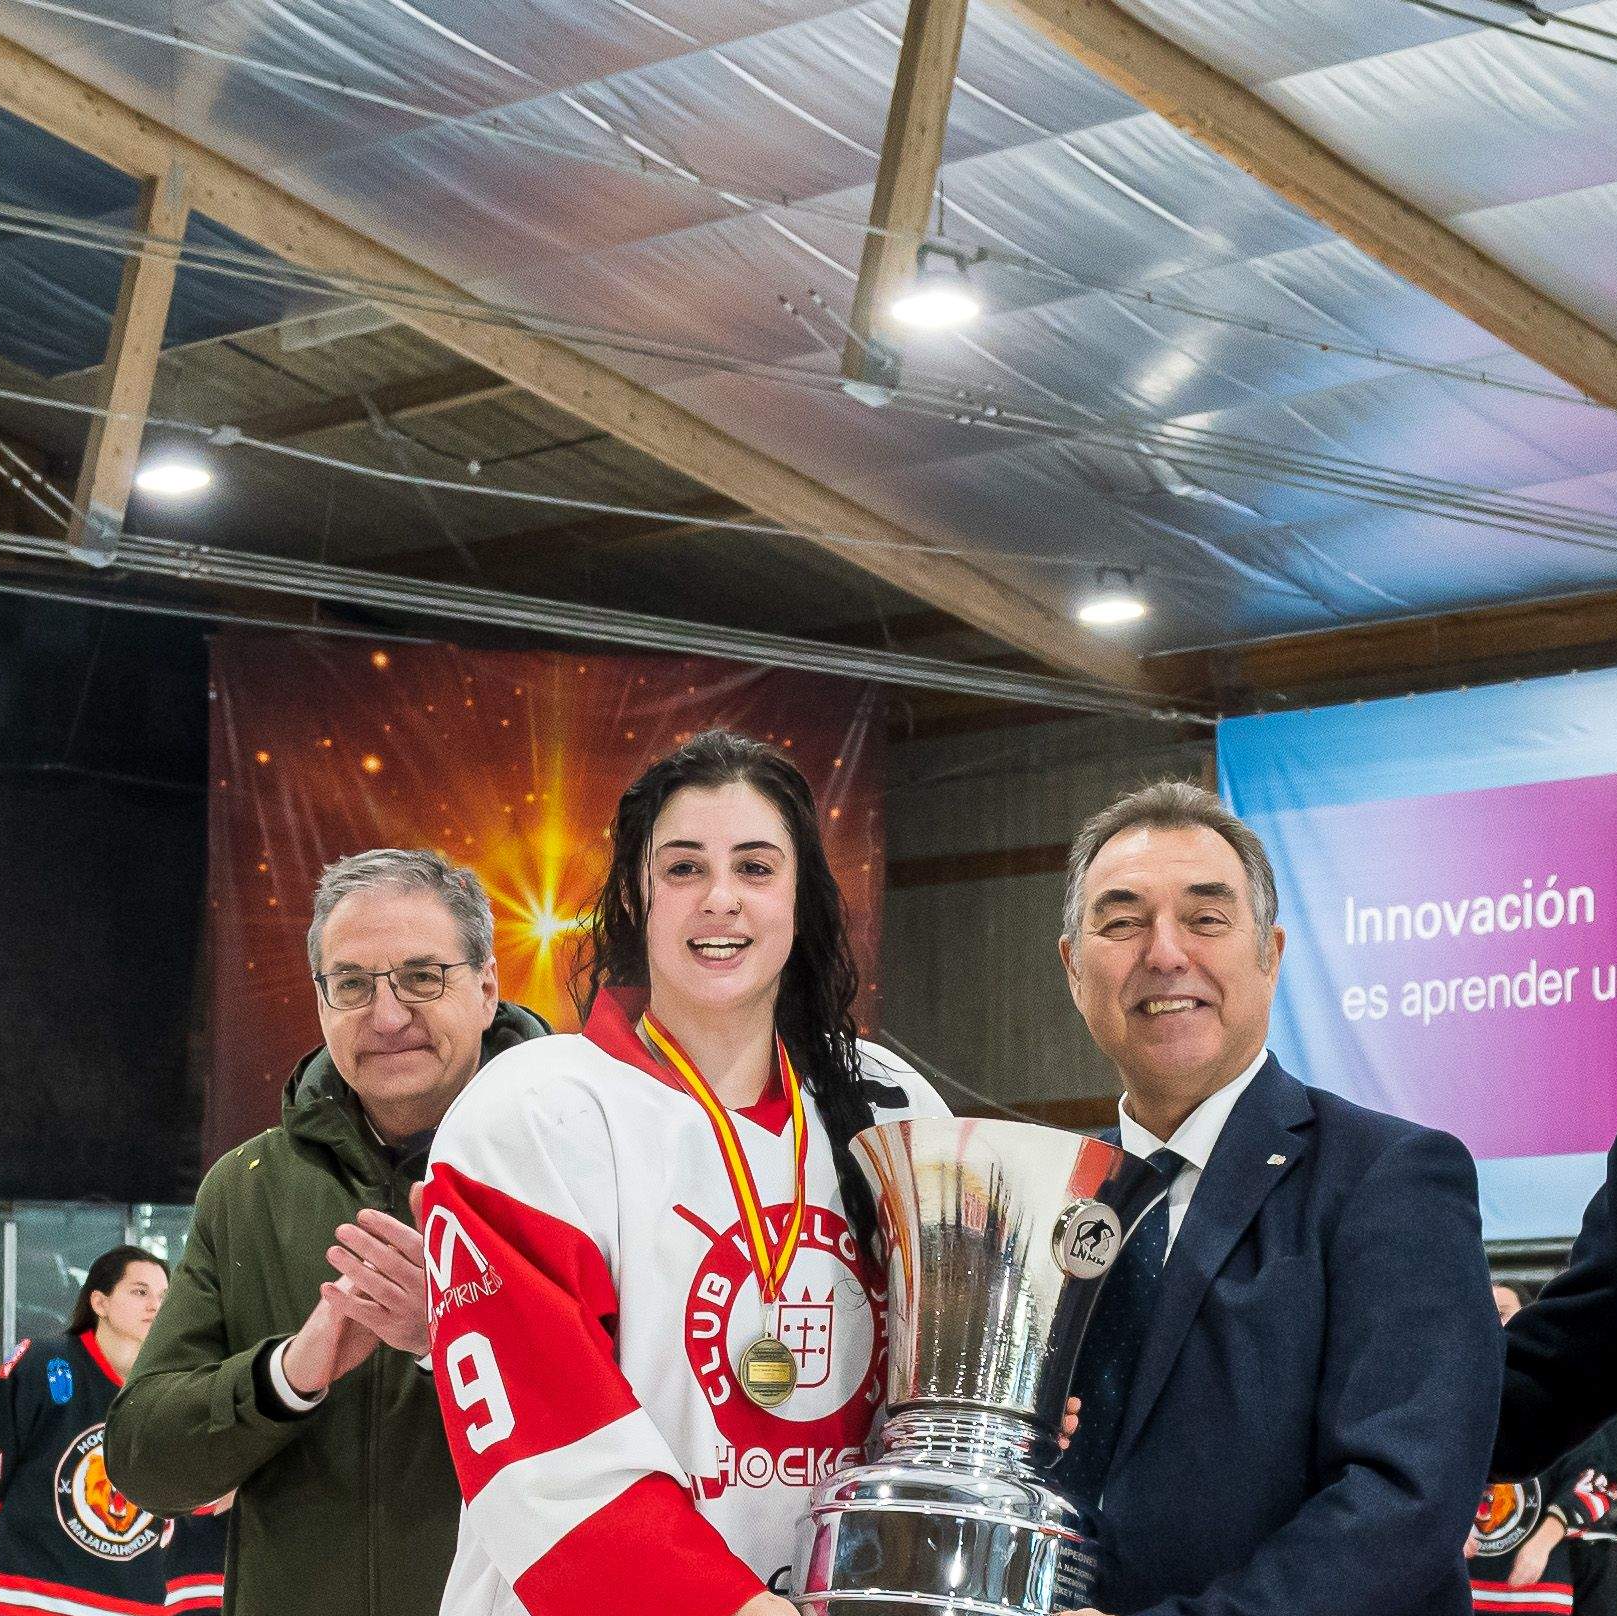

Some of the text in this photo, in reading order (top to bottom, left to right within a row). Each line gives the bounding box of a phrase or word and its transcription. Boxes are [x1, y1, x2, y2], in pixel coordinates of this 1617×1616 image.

[1345, 874, 1595, 945] Innovación
[1341, 988, 1389, 1021] es
[1399, 960, 1578, 1025] aprender
[692, 1271, 732, 1407] CLUB
[446, 1331, 516, 1455] 9
[715, 1445, 864, 1487] HOCK
